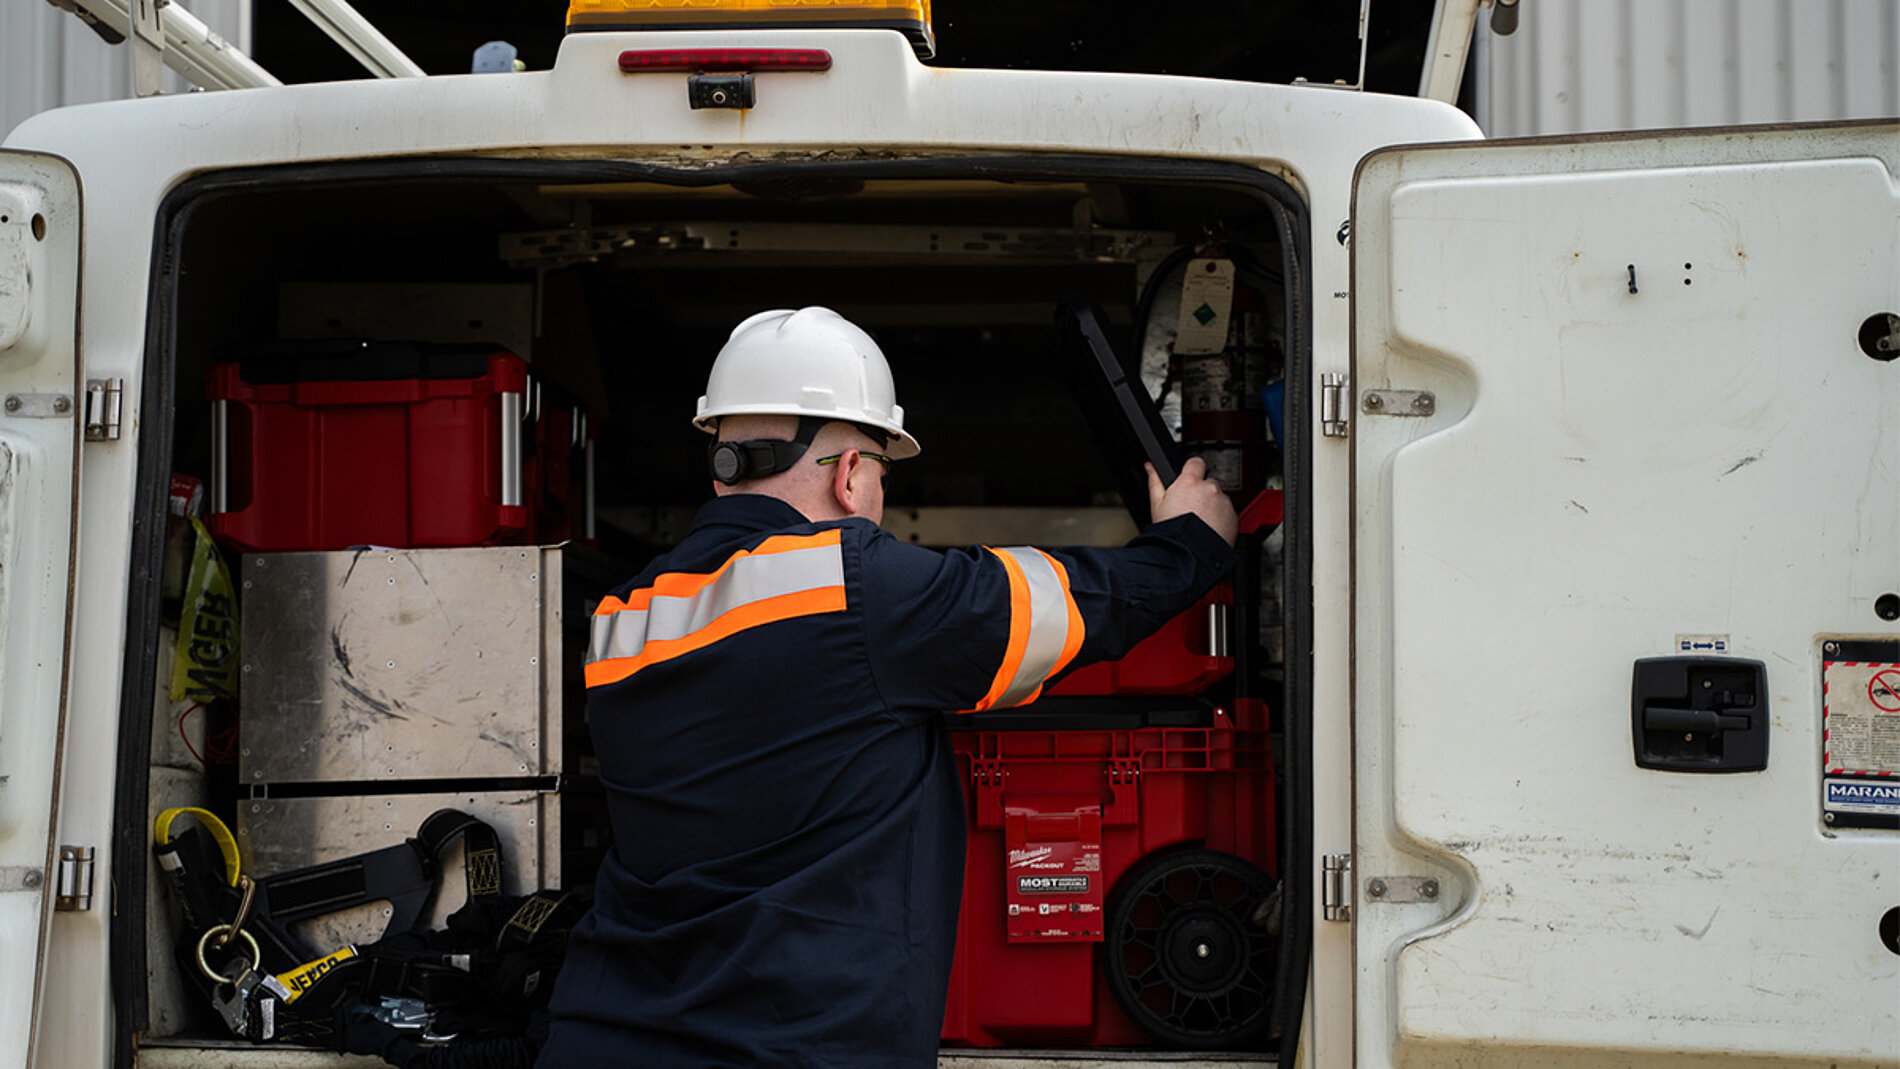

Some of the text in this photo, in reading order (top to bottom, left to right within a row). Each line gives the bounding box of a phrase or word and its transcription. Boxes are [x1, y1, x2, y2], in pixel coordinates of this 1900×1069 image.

[1334, 291, 1349, 299] MO
[1831, 785, 1900, 798] MARAN
[1020, 878, 1058, 887] MOST
